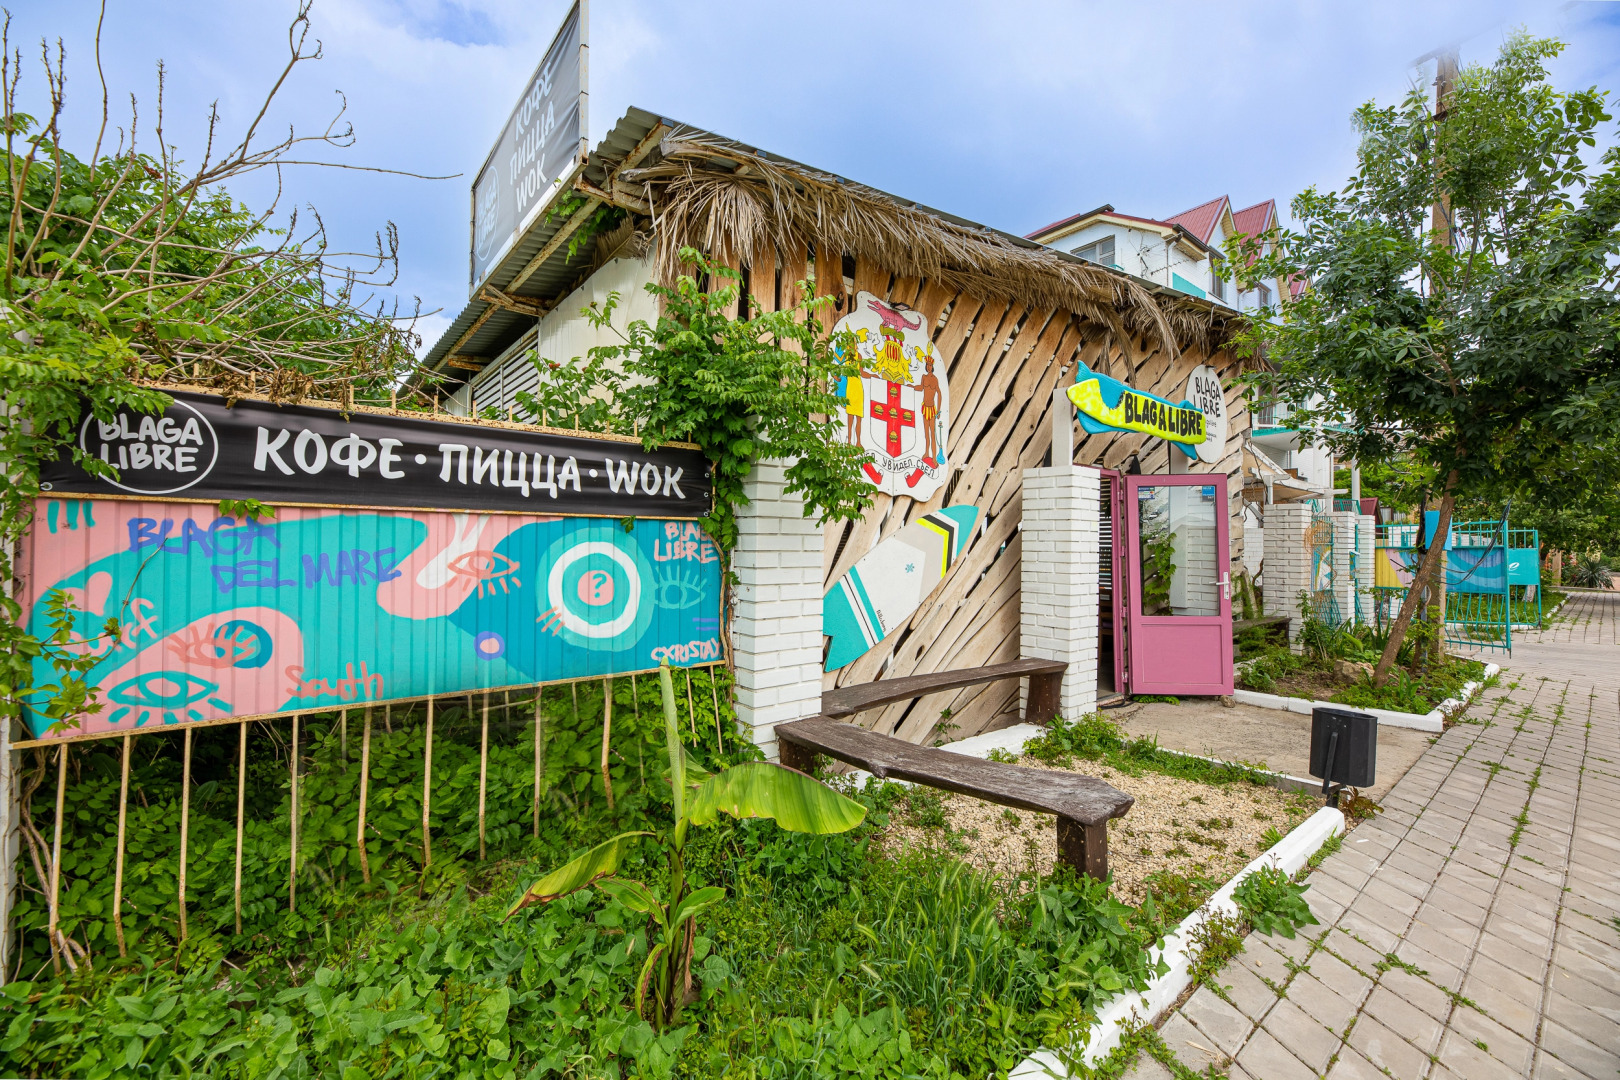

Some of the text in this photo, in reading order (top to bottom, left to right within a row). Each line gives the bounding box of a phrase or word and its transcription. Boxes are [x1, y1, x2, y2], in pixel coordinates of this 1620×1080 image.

[515, 61, 552, 142] КОФЕ
[510, 101, 555, 186] ПИЦЦА
[516, 153, 547, 213] WOK
[1193, 394, 1221, 418] LIBRE
[1195, 376, 1221, 401] BLAGA
[98, 413, 204, 446] BLAGA
[1125, 392, 1203, 436] BLAGA LIBRE
[101, 442, 199, 473] LIBRE
[253, 426, 686, 499] КОФЕ ПИЦЦА WOK
[127, 516, 282, 558] BLAGA
[653, 538, 719, 564] LIBRE
[210, 546, 403, 594] DEL MARE
[284, 660, 384, 701] South
